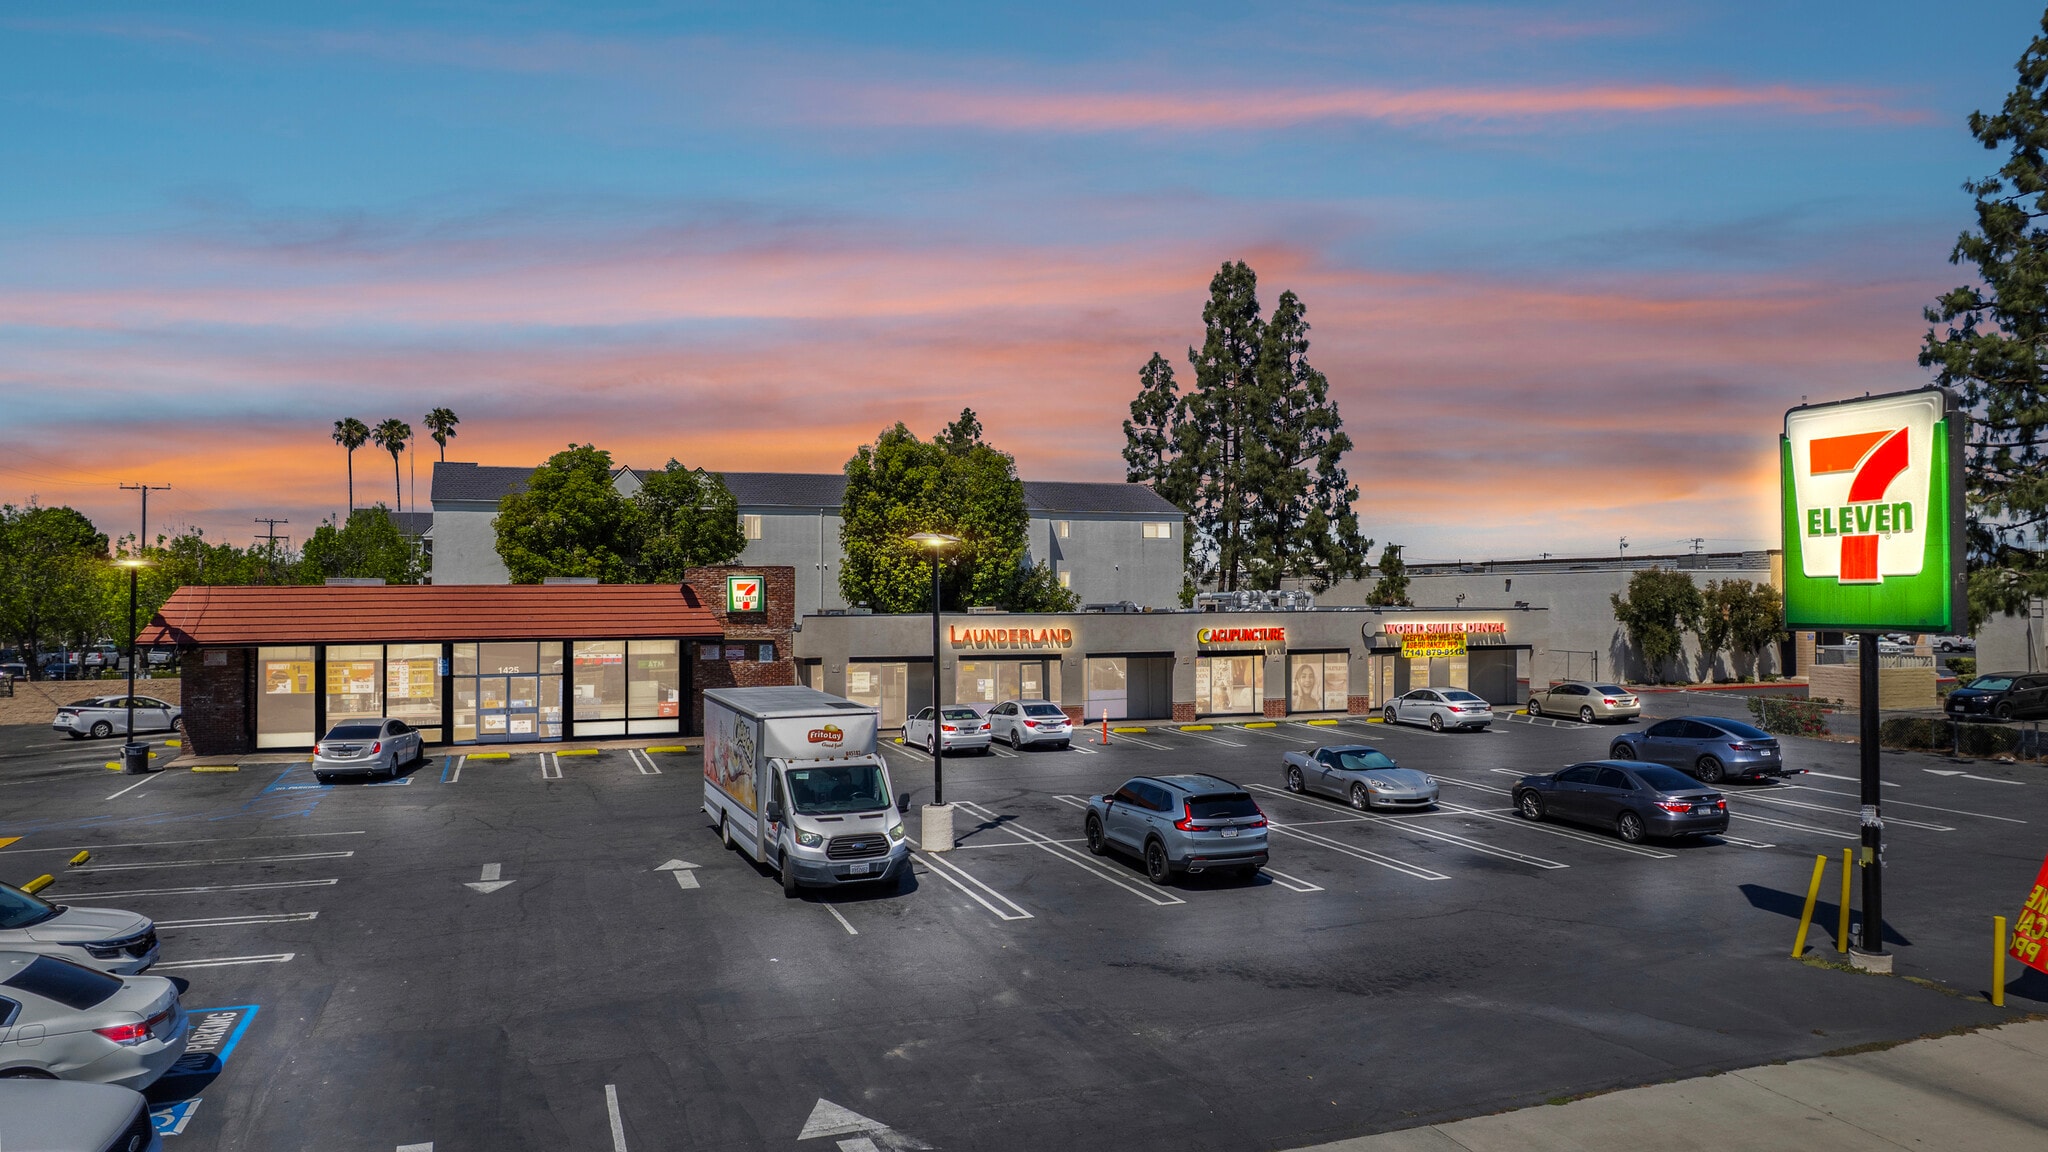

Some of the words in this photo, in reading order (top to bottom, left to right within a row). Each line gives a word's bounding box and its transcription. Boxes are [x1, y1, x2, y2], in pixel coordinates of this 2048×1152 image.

[1809, 426, 1910, 581] 7
[736, 583, 757, 610] 7
[949, 624, 1073, 644] LAUNDERLAND
[1209, 627, 1285, 643] ACUPUNCTURE
[1384, 623, 1425, 635] WORLD
[1427, 623, 1465, 634] SMILES
[1466, 622, 1507, 633] DENTAL
[497, 666, 520, 674] 1425
[648, 660, 664, 668] ATM
[184, 1012, 238, 1053] PARKING
